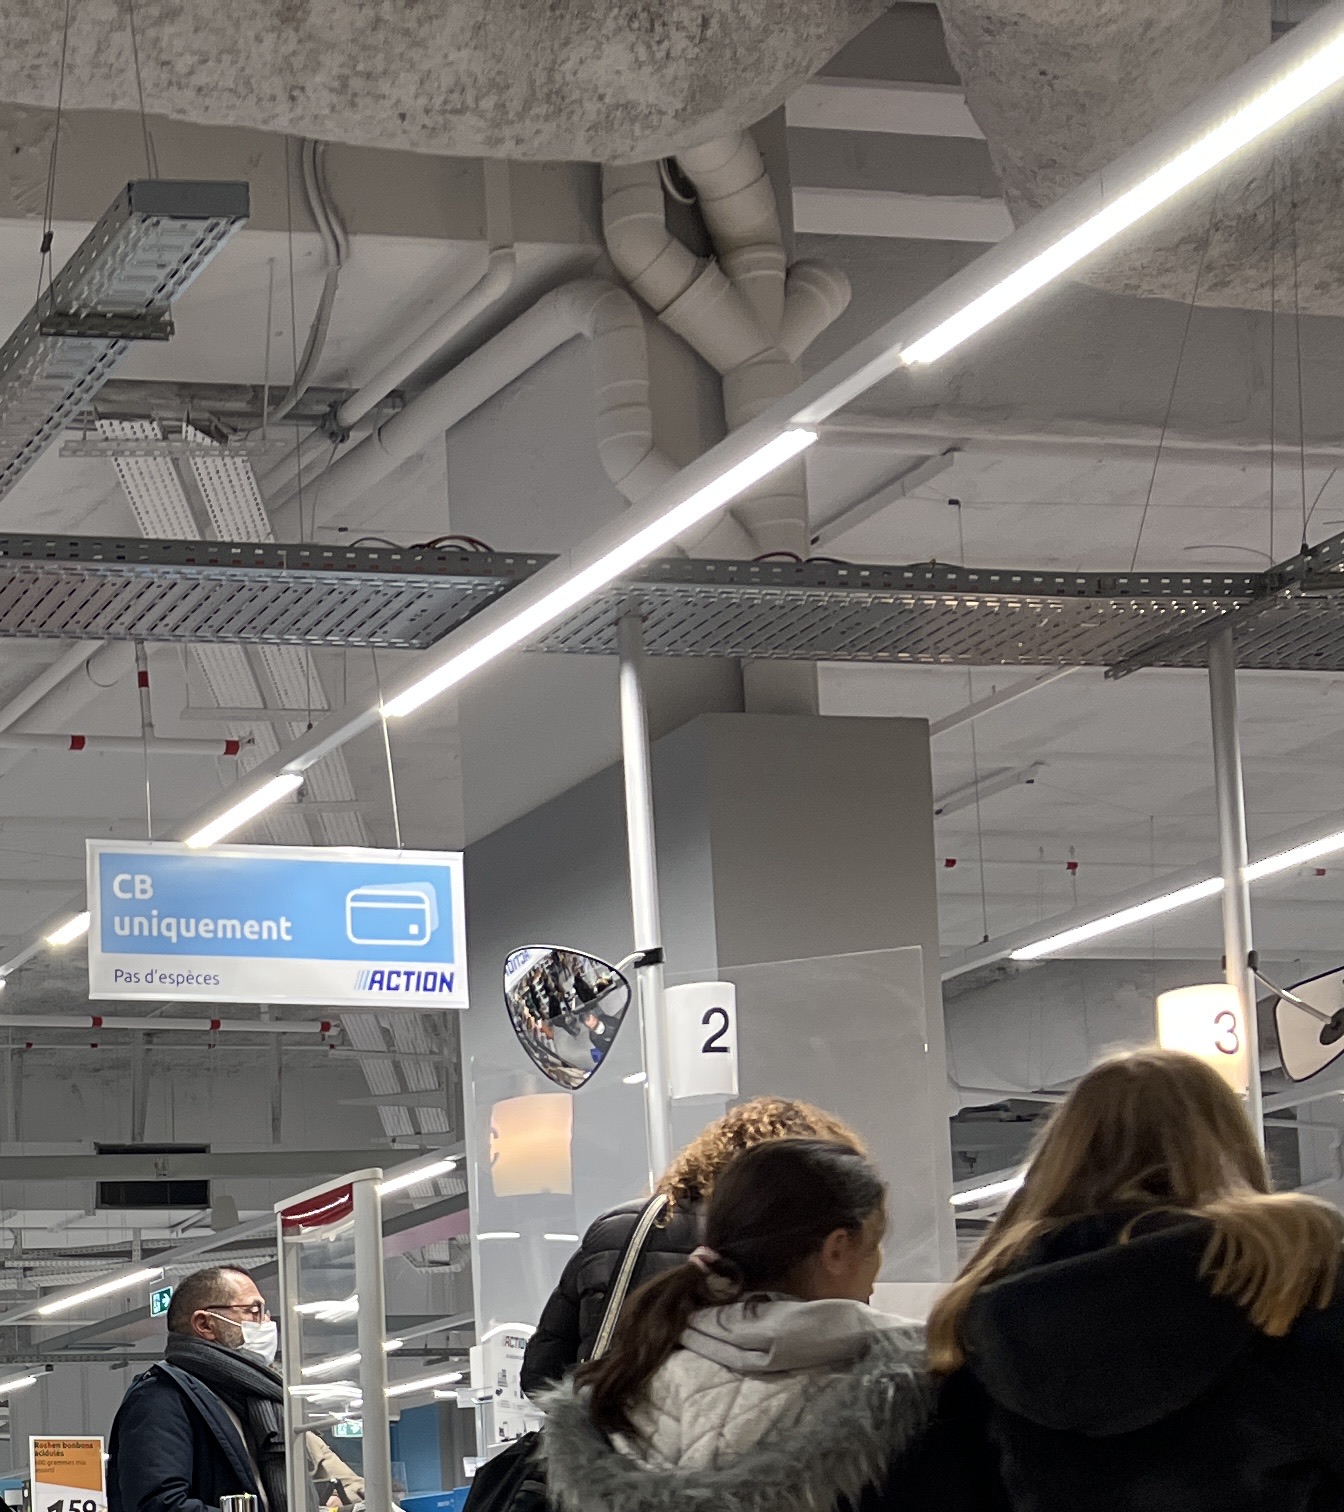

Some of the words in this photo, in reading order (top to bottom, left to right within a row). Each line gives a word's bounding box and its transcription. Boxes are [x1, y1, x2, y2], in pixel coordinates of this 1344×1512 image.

[113, 874, 154, 899] CB
[114, 910, 292, 943] uniquement
[114, 968, 140, 984] Pas
[145, 968, 220, 987] d'espèces
[367, 970, 455, 993] ACTION
[701, 1007, 731, 1053] 2
[1213, 1010, 1240, 1055] 3
